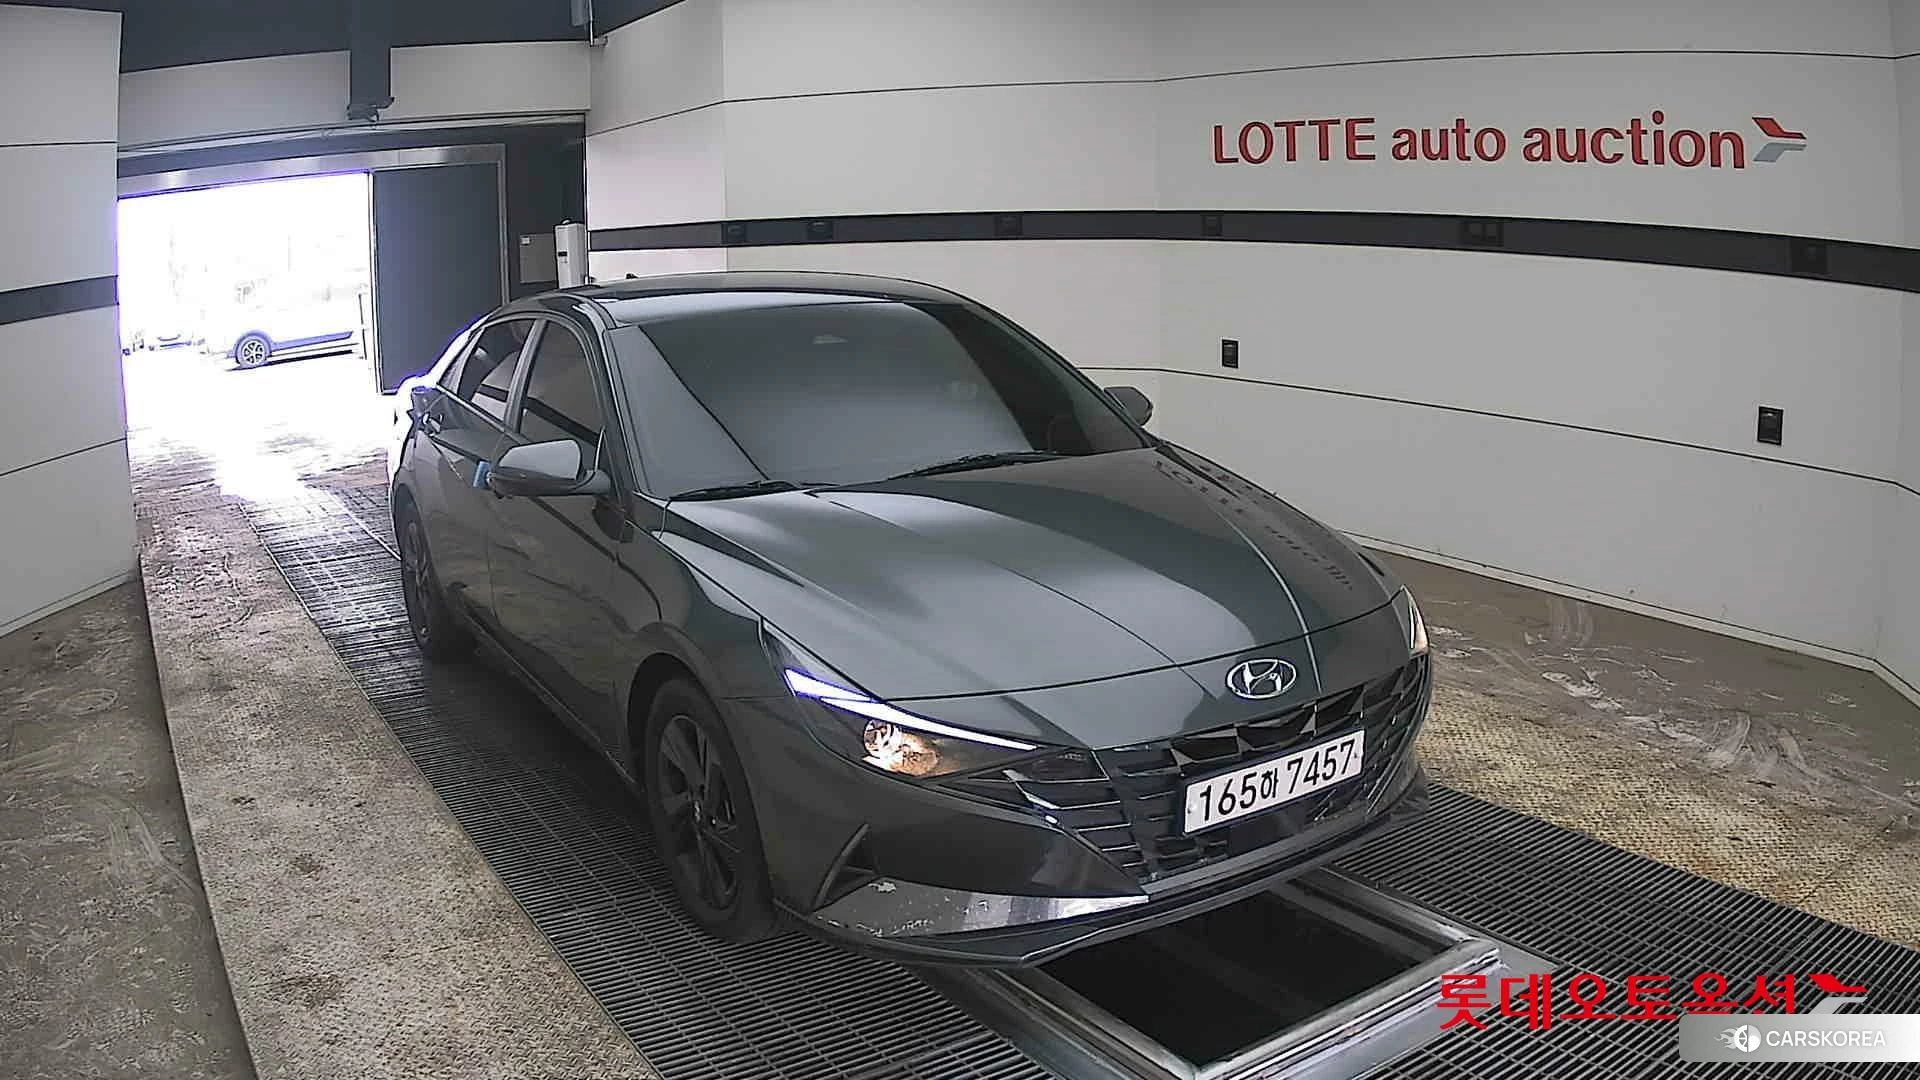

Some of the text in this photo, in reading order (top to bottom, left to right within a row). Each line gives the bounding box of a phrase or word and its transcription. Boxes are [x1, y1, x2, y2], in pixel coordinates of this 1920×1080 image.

[1212, 110, 1745, 169] LOTTE auto auction
[1199, 738, 1356, 822] 165하 7457
